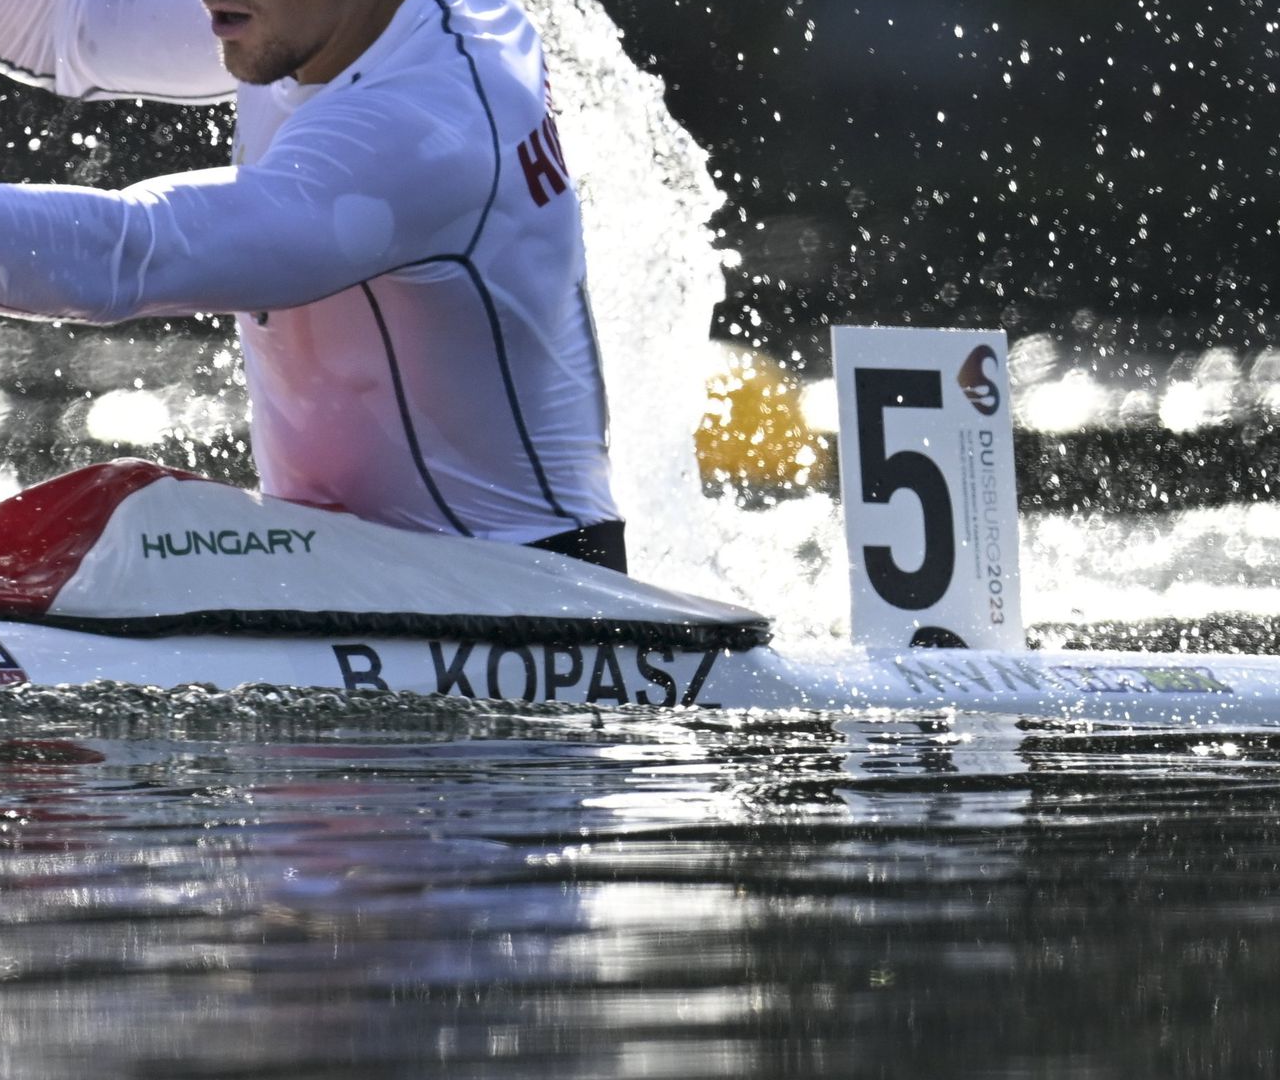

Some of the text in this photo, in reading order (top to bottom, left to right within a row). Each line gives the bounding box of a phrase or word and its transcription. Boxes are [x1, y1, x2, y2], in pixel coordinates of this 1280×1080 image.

[854, 368, 955, 611] 5
[142, 529, 317, 559] HUNGARY
[428, 641, 723, 708] KOPASZ
